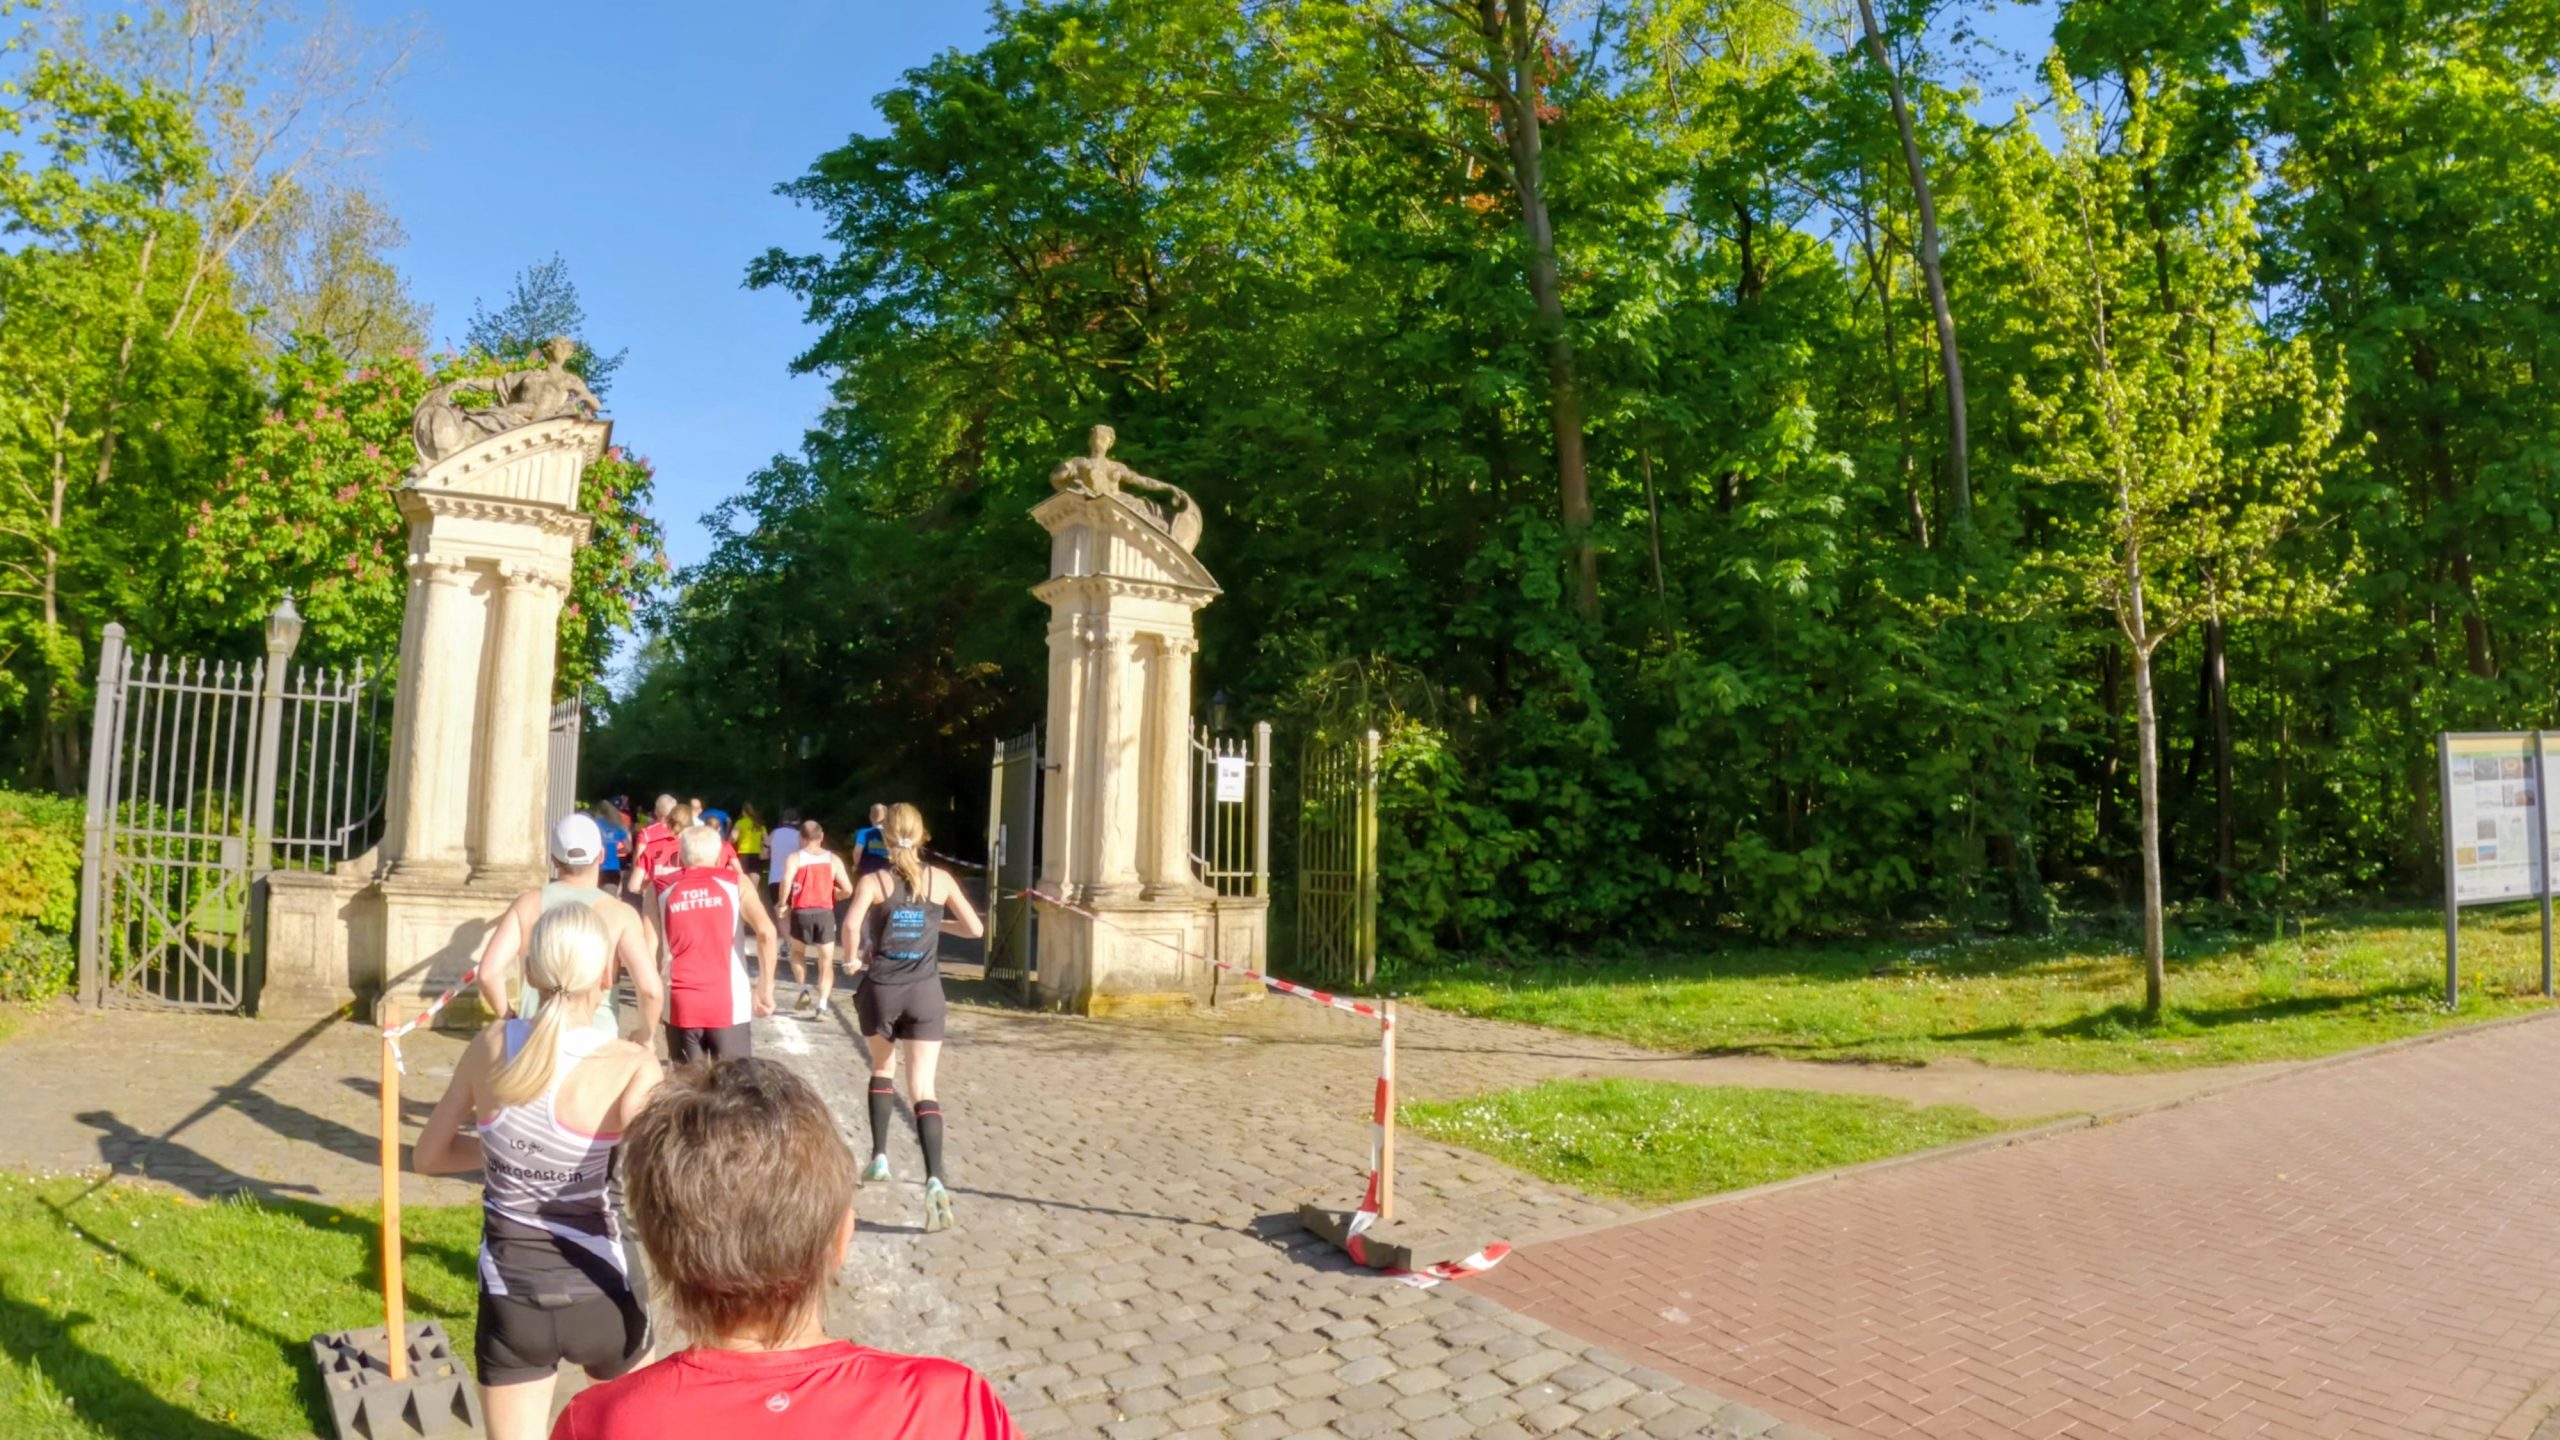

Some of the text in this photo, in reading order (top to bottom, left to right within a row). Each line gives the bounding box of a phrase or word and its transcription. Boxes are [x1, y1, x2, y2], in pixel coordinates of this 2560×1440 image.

[681, 888, 709, 900] TGH
[670, 896, 723, 913] WETTER
[509, 1139, 526, 1150] LG
[488, 1159, 584, 1183] Wittgenstein
